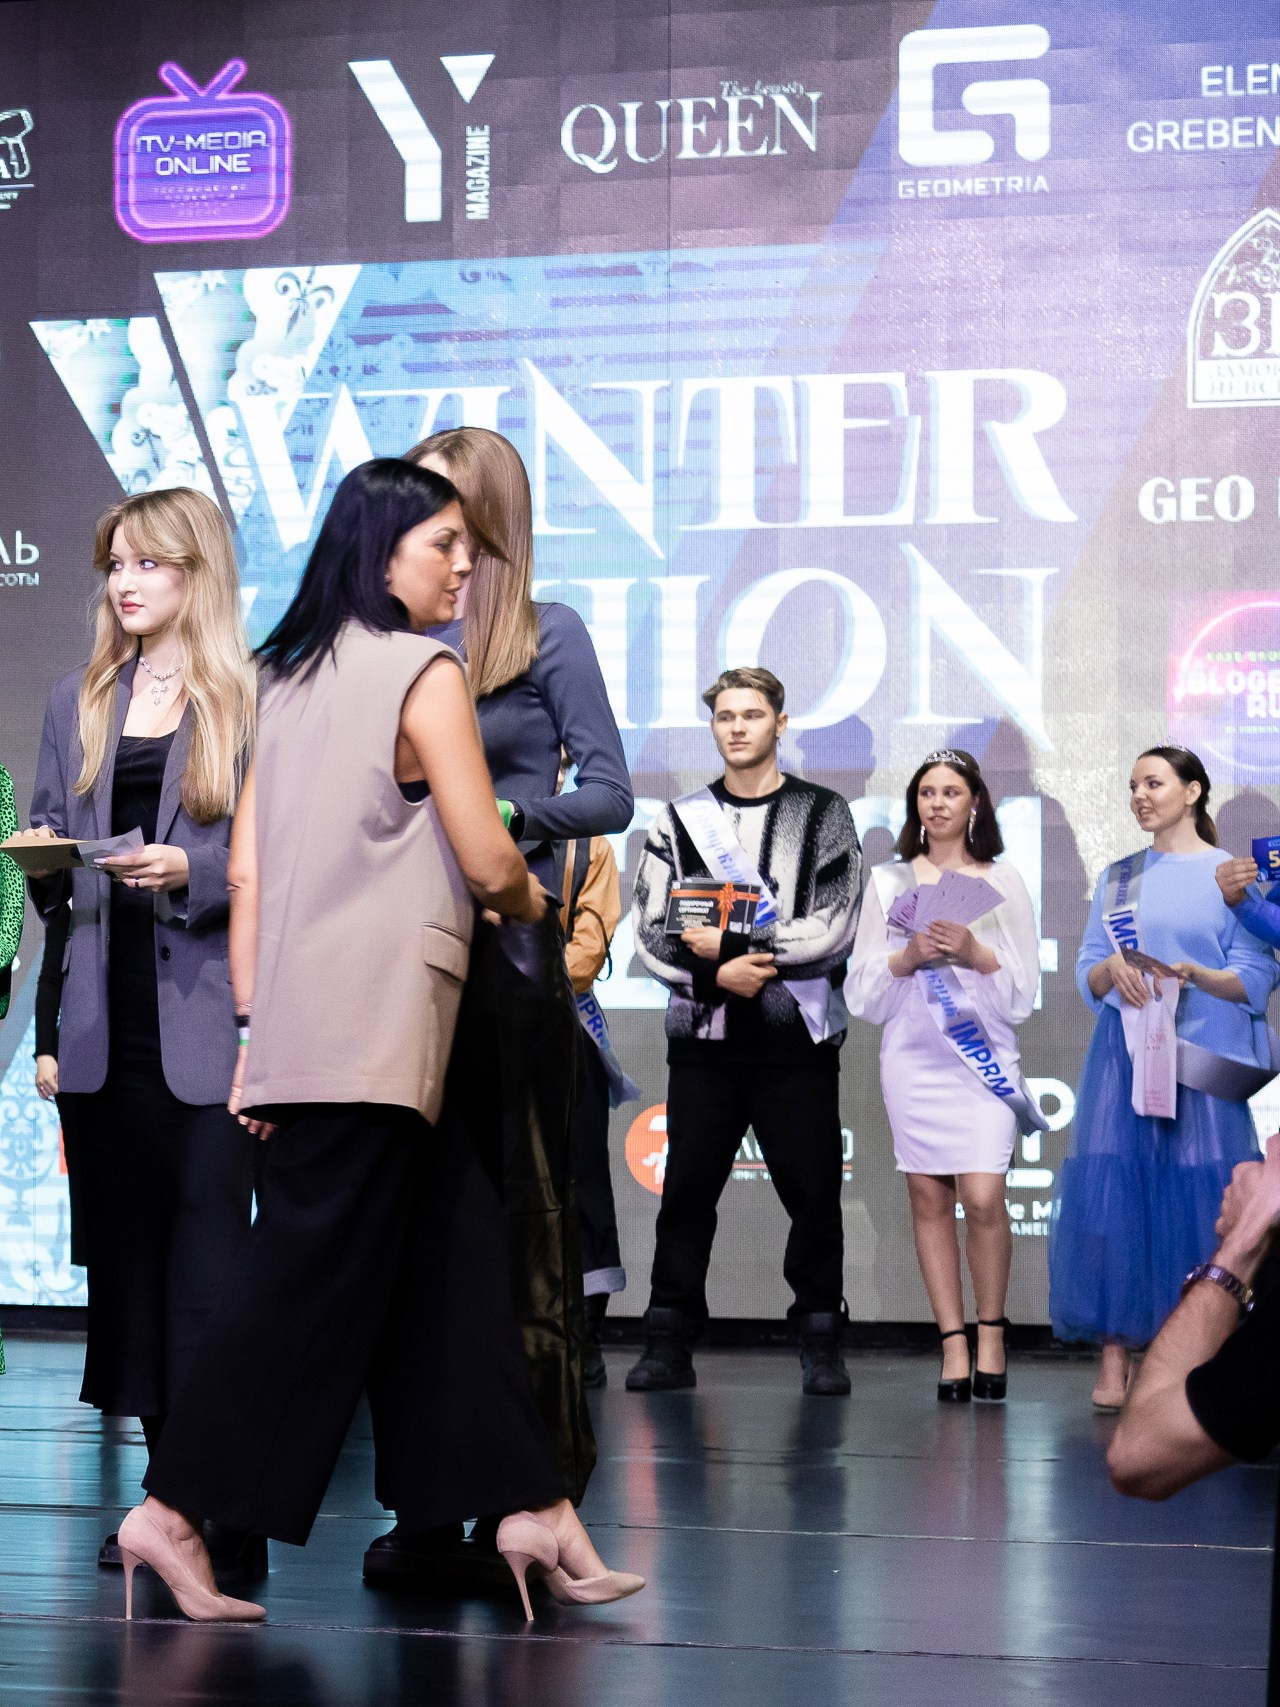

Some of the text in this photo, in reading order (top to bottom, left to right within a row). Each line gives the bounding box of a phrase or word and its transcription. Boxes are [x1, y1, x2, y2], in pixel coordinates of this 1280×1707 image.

[561, 91, 823, 174] QUEEN
[155, 153, 252, 176] ONLINE
[465, 124, 491, 220] MAGAZINE
[898, 175, 1049, 200] GEOMETRIA
[1138, 474, 1255, 525] GEO
